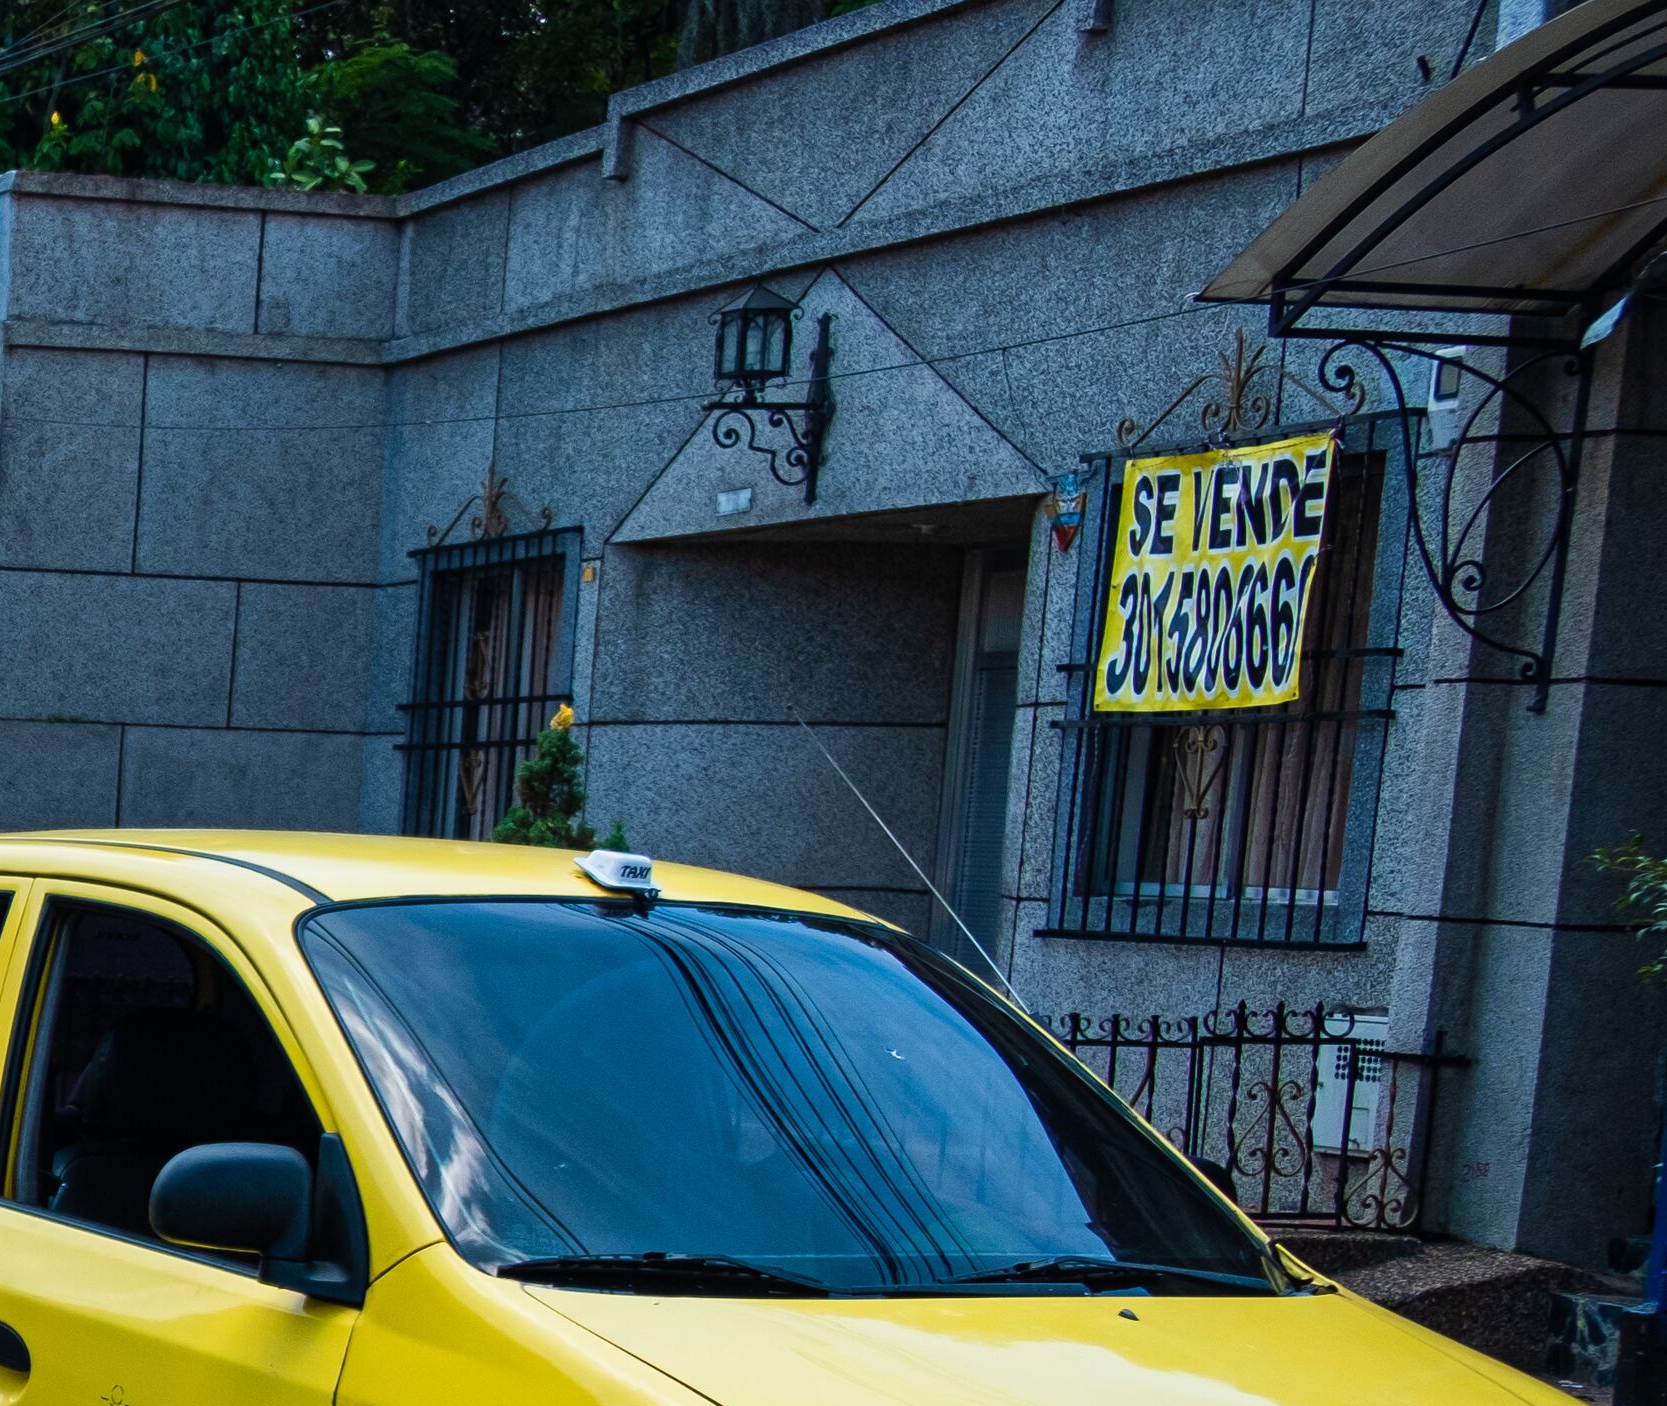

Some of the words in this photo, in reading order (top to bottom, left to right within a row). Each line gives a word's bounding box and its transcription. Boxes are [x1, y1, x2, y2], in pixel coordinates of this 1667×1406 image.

[1129, 472, 1181, 557] SE
[1192, 449, 1328, 552] VENDE
[620, 864, 652, 879] TAXI
